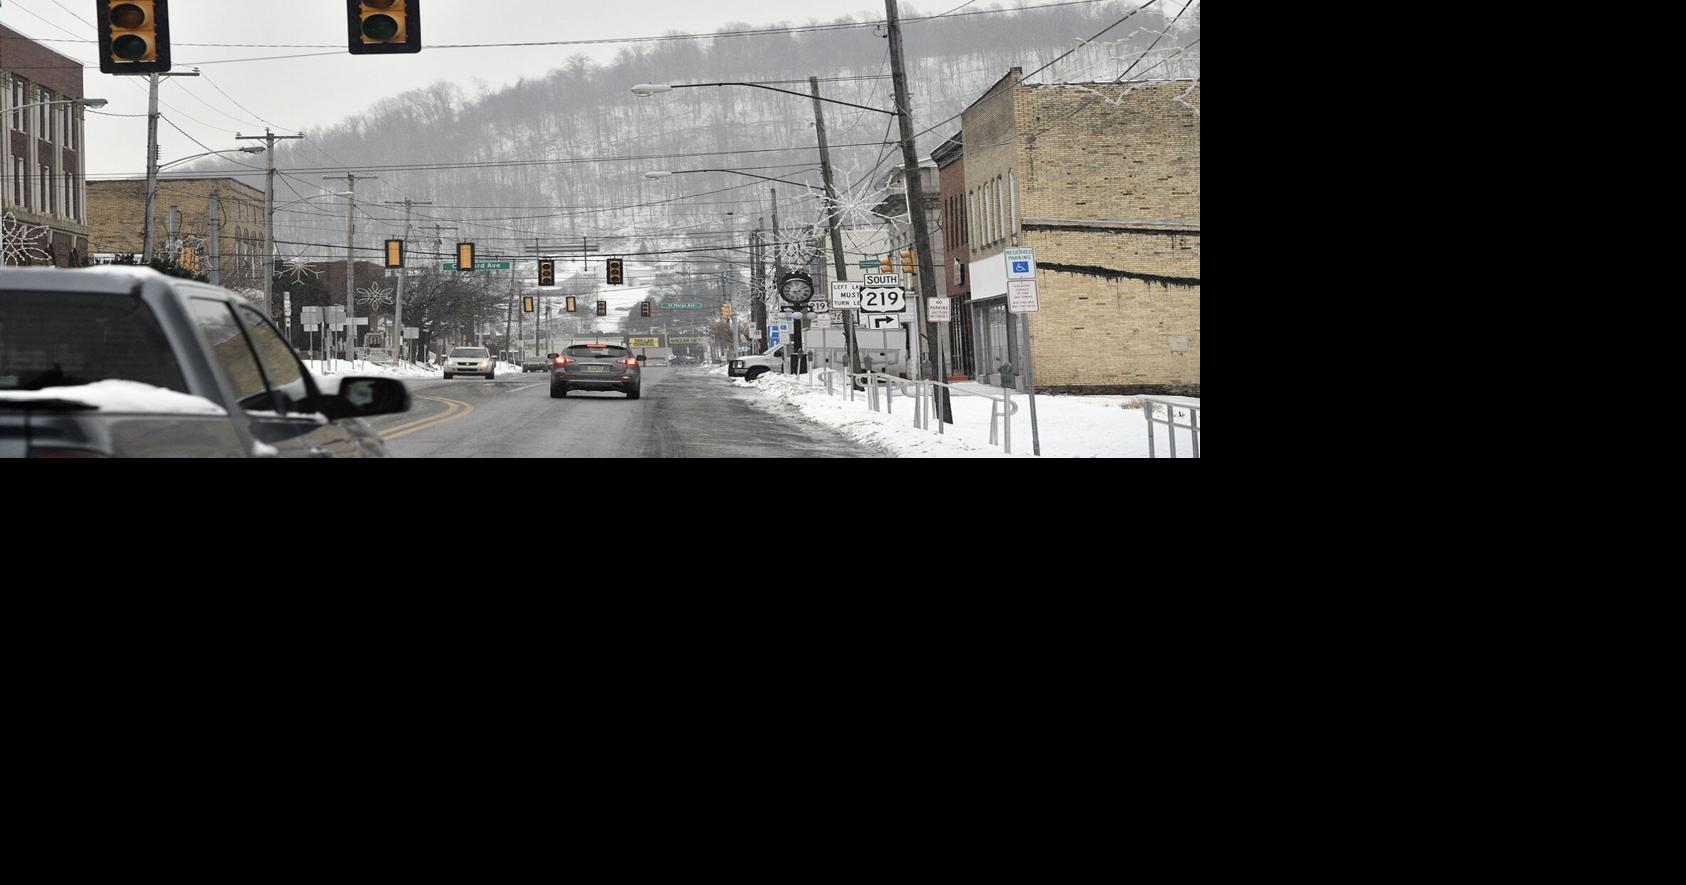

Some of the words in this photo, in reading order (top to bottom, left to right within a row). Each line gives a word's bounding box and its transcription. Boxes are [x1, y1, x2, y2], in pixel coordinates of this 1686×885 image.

[867, 275, 897, 285] SOUTH
[866, 291, 899, 306] 219
[809, 302, 827, 310] 219
